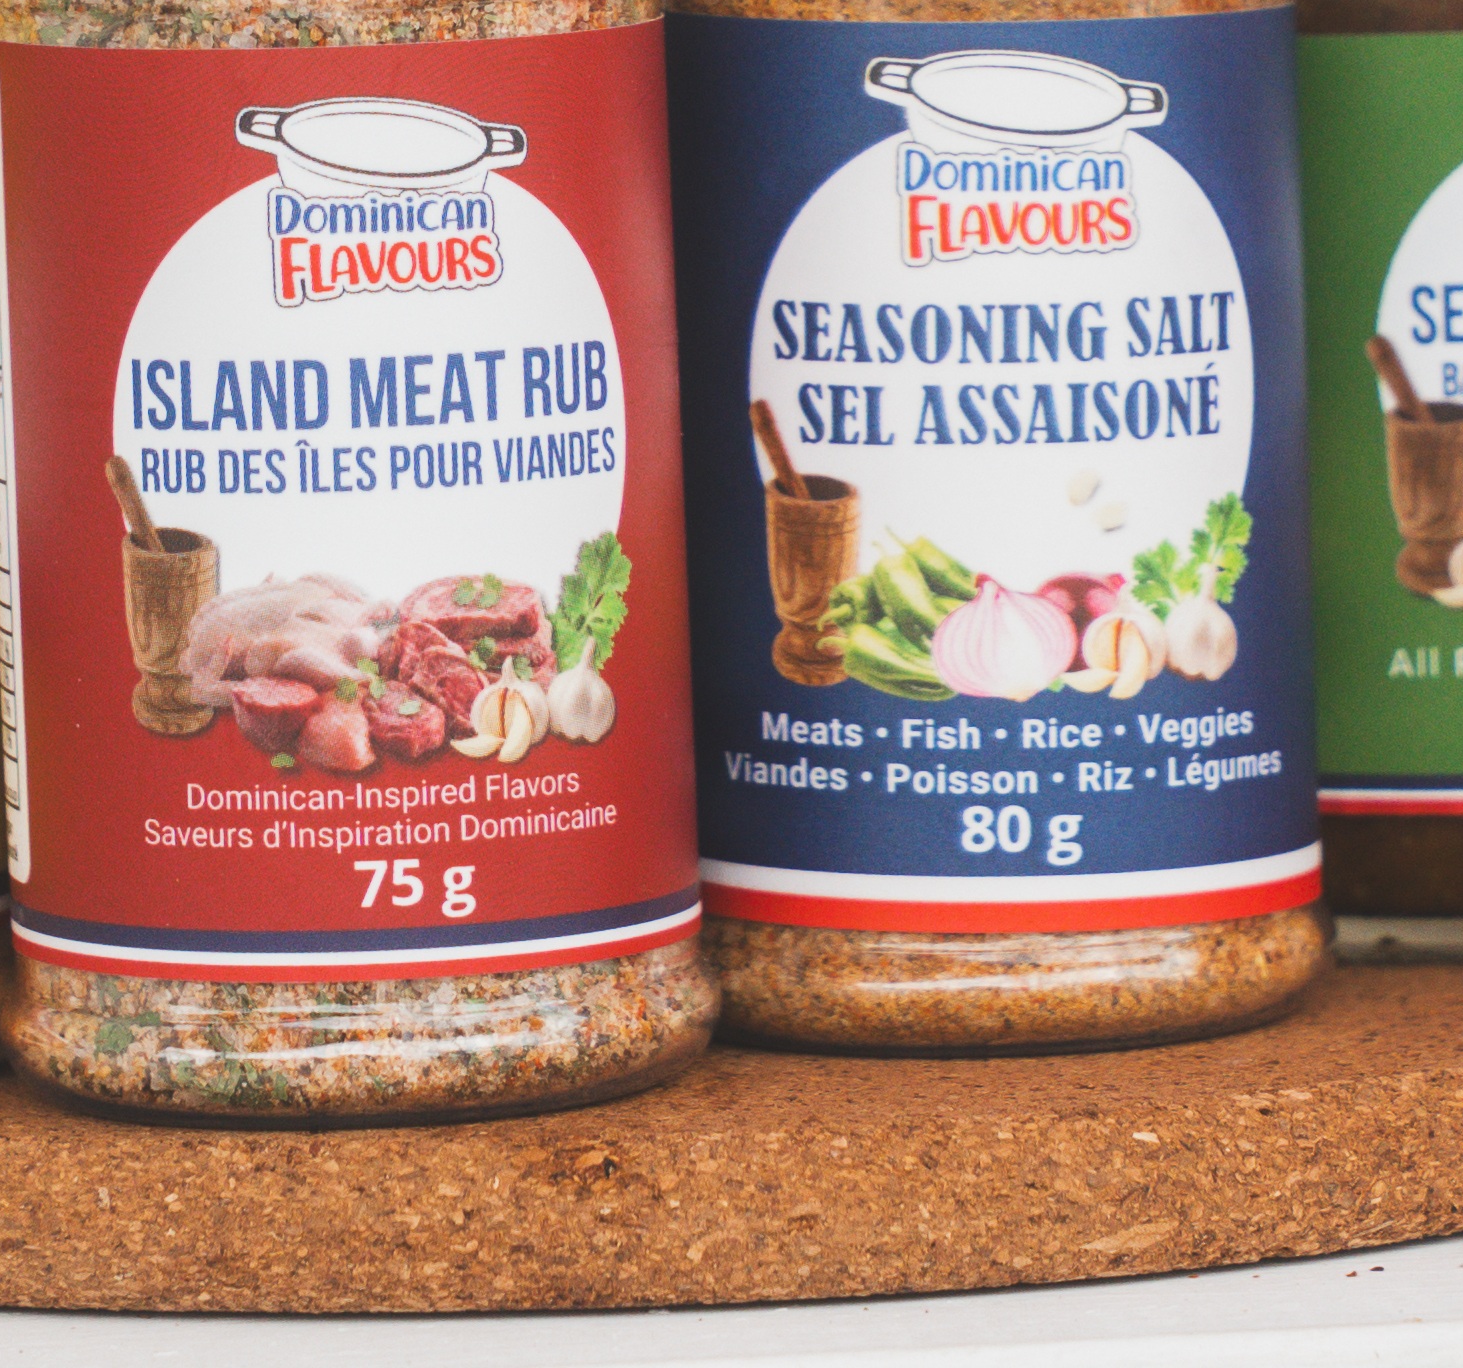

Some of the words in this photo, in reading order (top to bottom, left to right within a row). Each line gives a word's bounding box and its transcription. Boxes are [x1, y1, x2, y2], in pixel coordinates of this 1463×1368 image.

[908, 196, 1132, 258] FLAVOURS
[281, 237, 496, 299] FLAVOURS
[772, 299, 1107, 363] SEASONING
[1127, 291, 1234, 357] SALT
[132, 358, 329, 431] ISLAND
[350, 349, 504, 428] MEAT
[524, 340, 608, 417] RUB
[798, 384, 895, 446] SEL
[914, 363, 1220, 445] ASSAISONÉ
[142, 448, 206, 494] RUB
[219, 448, 286, 494] DES
[295, 440, 378, 493] ÎLES
[391, 441, 483, 489] POUR
[494, 428, 616, 482] VIANDES
[1389, 647, 1440, 678] All
[762, 711, 863, 747] Meats
[902, 718, 981, 749] Fish
[1023, 717, 1102, 748] Rice
[1138, 707, 1254, 749] Veggies
[187, 778, 476, 814] Dominican-Inspired
[486, 772, 580, 801] Flavors
[726, 752, 848, 791] Viandes
[887, 763, 1038, 794] Poisson
[1079, 761, 1133, 792] Riz
[1167, 747, 1282, 795] Légumes
[144, 818, 254, 849] Saveurs
[461, 800, 618, 841] Dominicaine
[961, 805, 1031, 853] 80
[1047, 814, 1083, 866] g
[353, 859, 424, 908] 75
[441, 866, 476, 917] g
